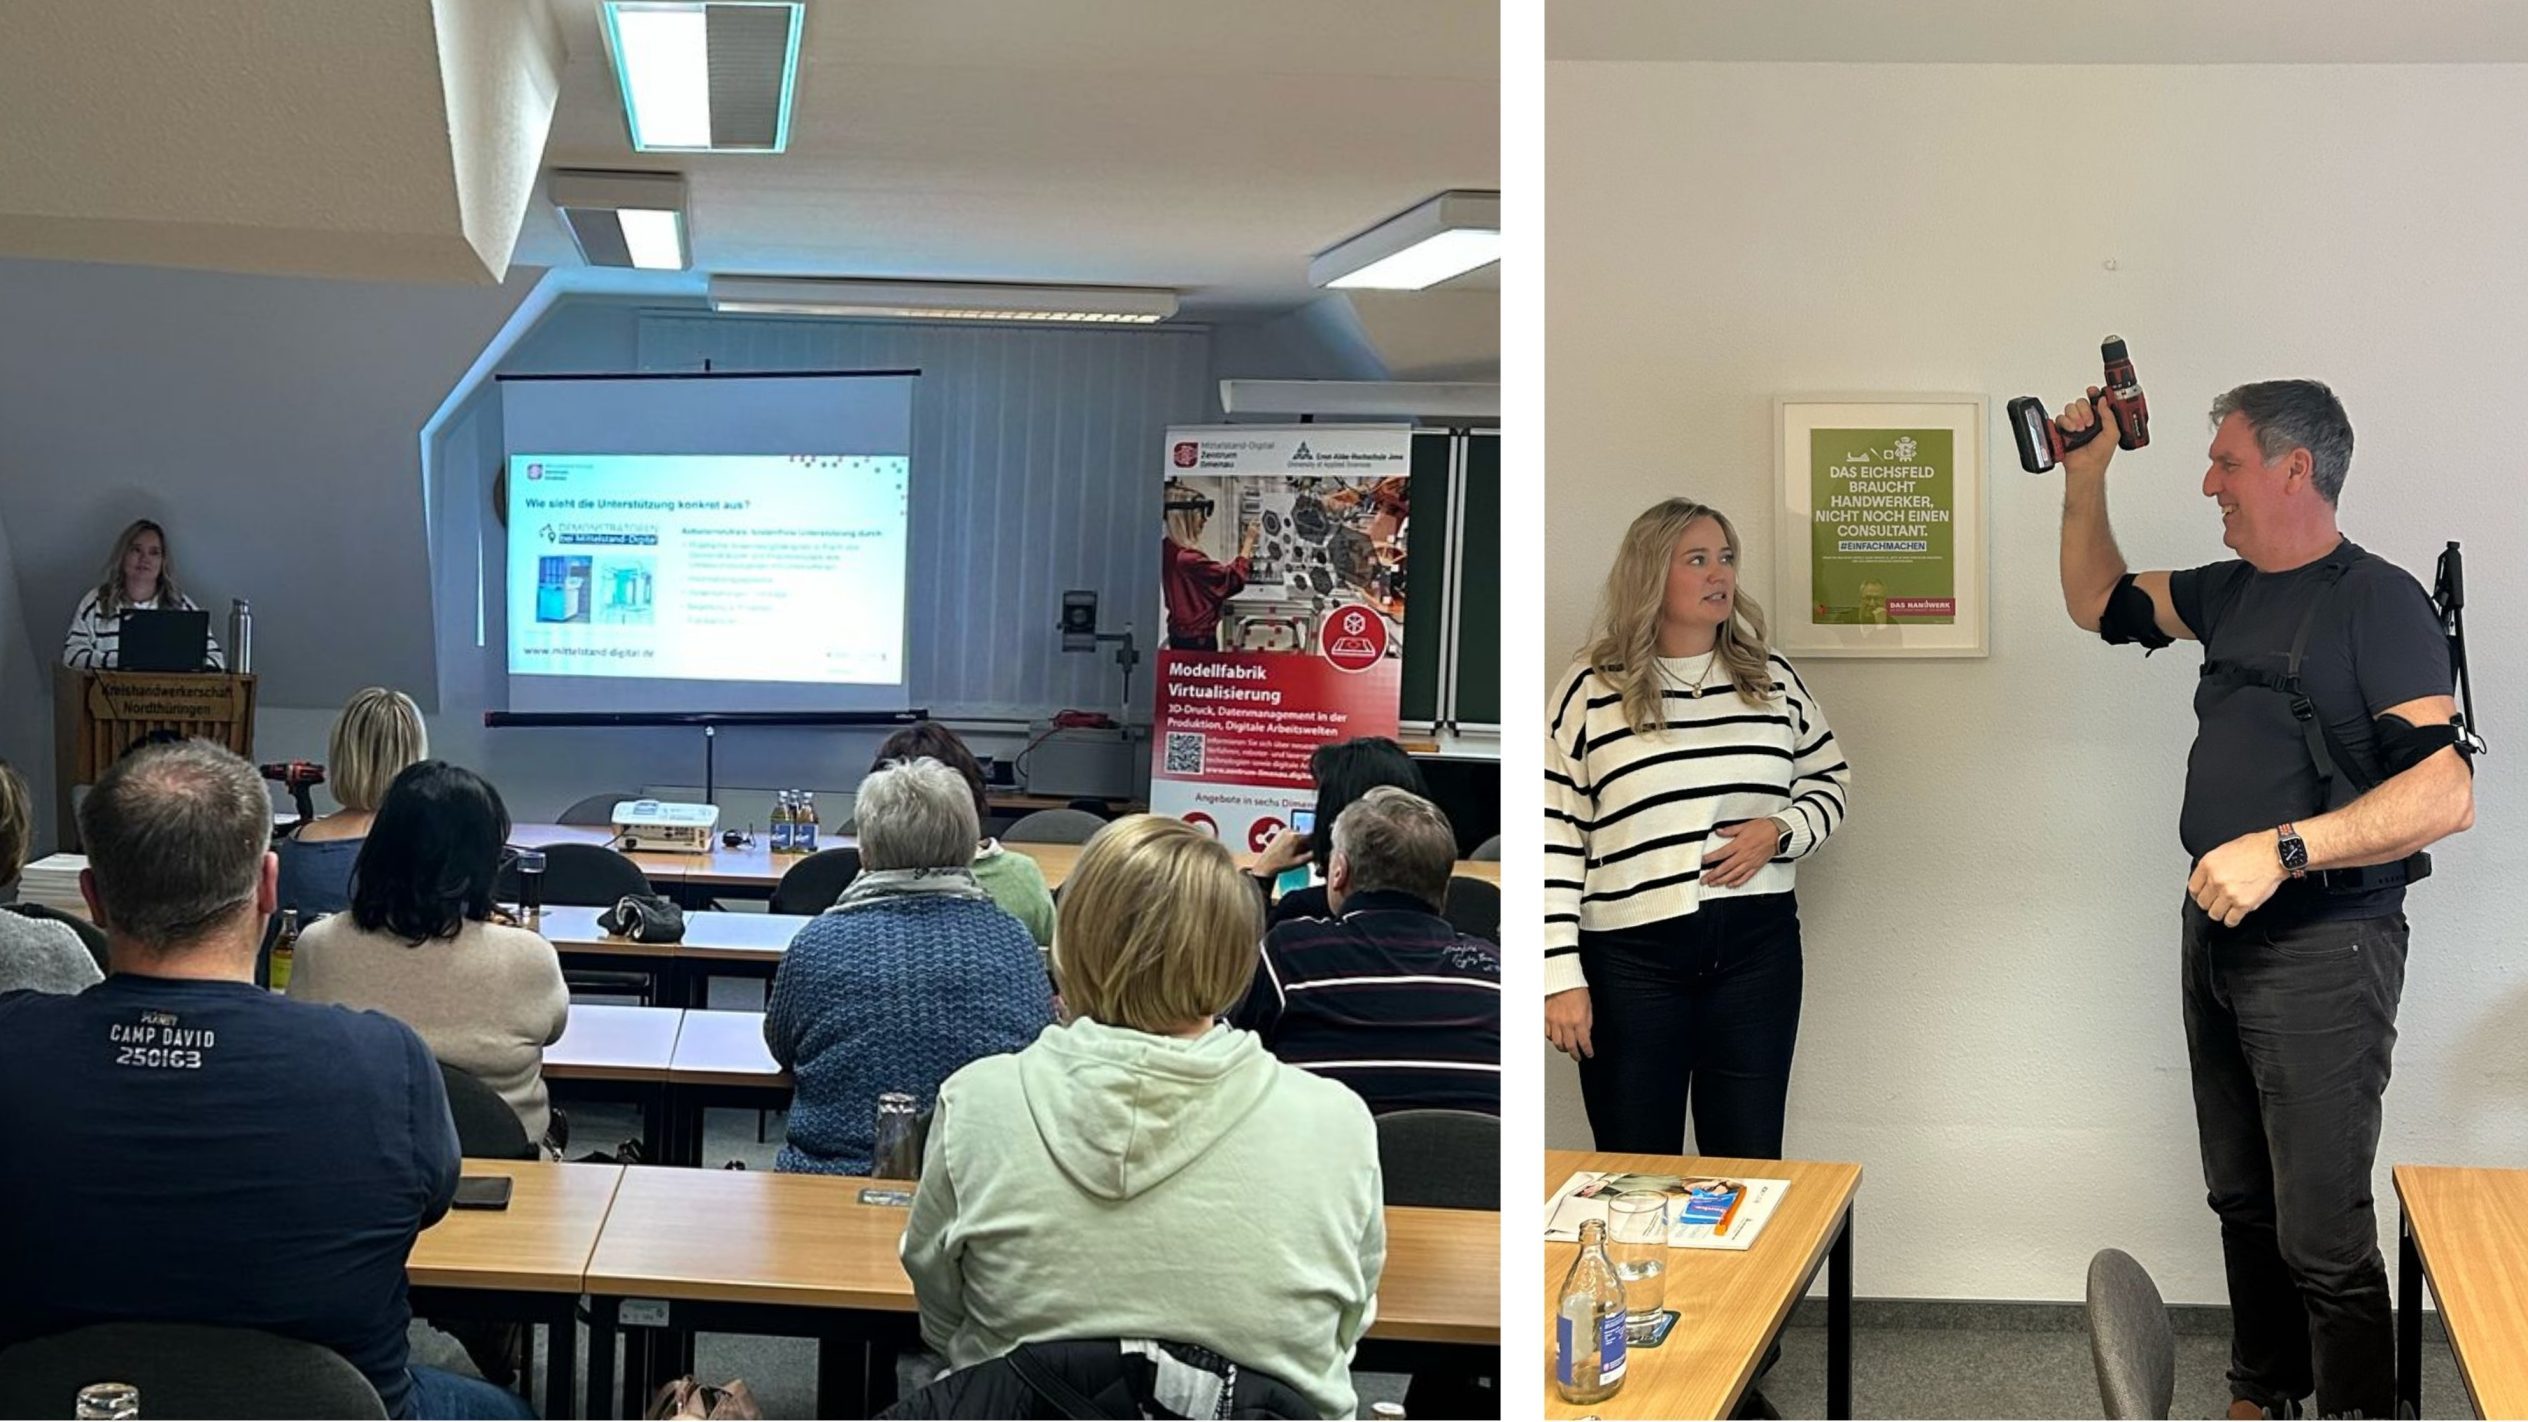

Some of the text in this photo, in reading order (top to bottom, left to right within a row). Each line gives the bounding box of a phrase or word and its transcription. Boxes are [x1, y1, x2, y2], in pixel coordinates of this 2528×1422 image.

[1830, 466, 1934, 478] DAS EICHSFELD
[1849, 481, 1916, 493] BRAUCHT
[525, 497, 546, 508] Wie
[548, 498, 576, 509] sieht
[577, 498, 594, 509] die
[1831, 495, 1934, 509] HANDWERKER,
[1815, 510, 1950, 522] NICHT NOCH EINEN
[1837, 525, 1928, 537] CONSULTANT.
[1840, 542, 1925, 551] #EINFACHMACHEN
[1169, 662, 1267, 680] Modellfabrik
[1168, 683, 1281, 705] Virtualisierung
[123, 702, 211, 717] Nordthüringen
[1218, 705, 1315, 721] Datenmanagement
[1317, 711, 1327, 721] in
[1329, 712, 1348, 722] der
[1167, 717, 1339, 737] Produktion, Digitale Arbeitswelten
[1195, 793, 1241, 804] Angebote
[1243, 795, 1252, 804] in
[110, 1024, 215, 1048] CAMP DAVID
[116, 1047, 202, 1069] 250163
